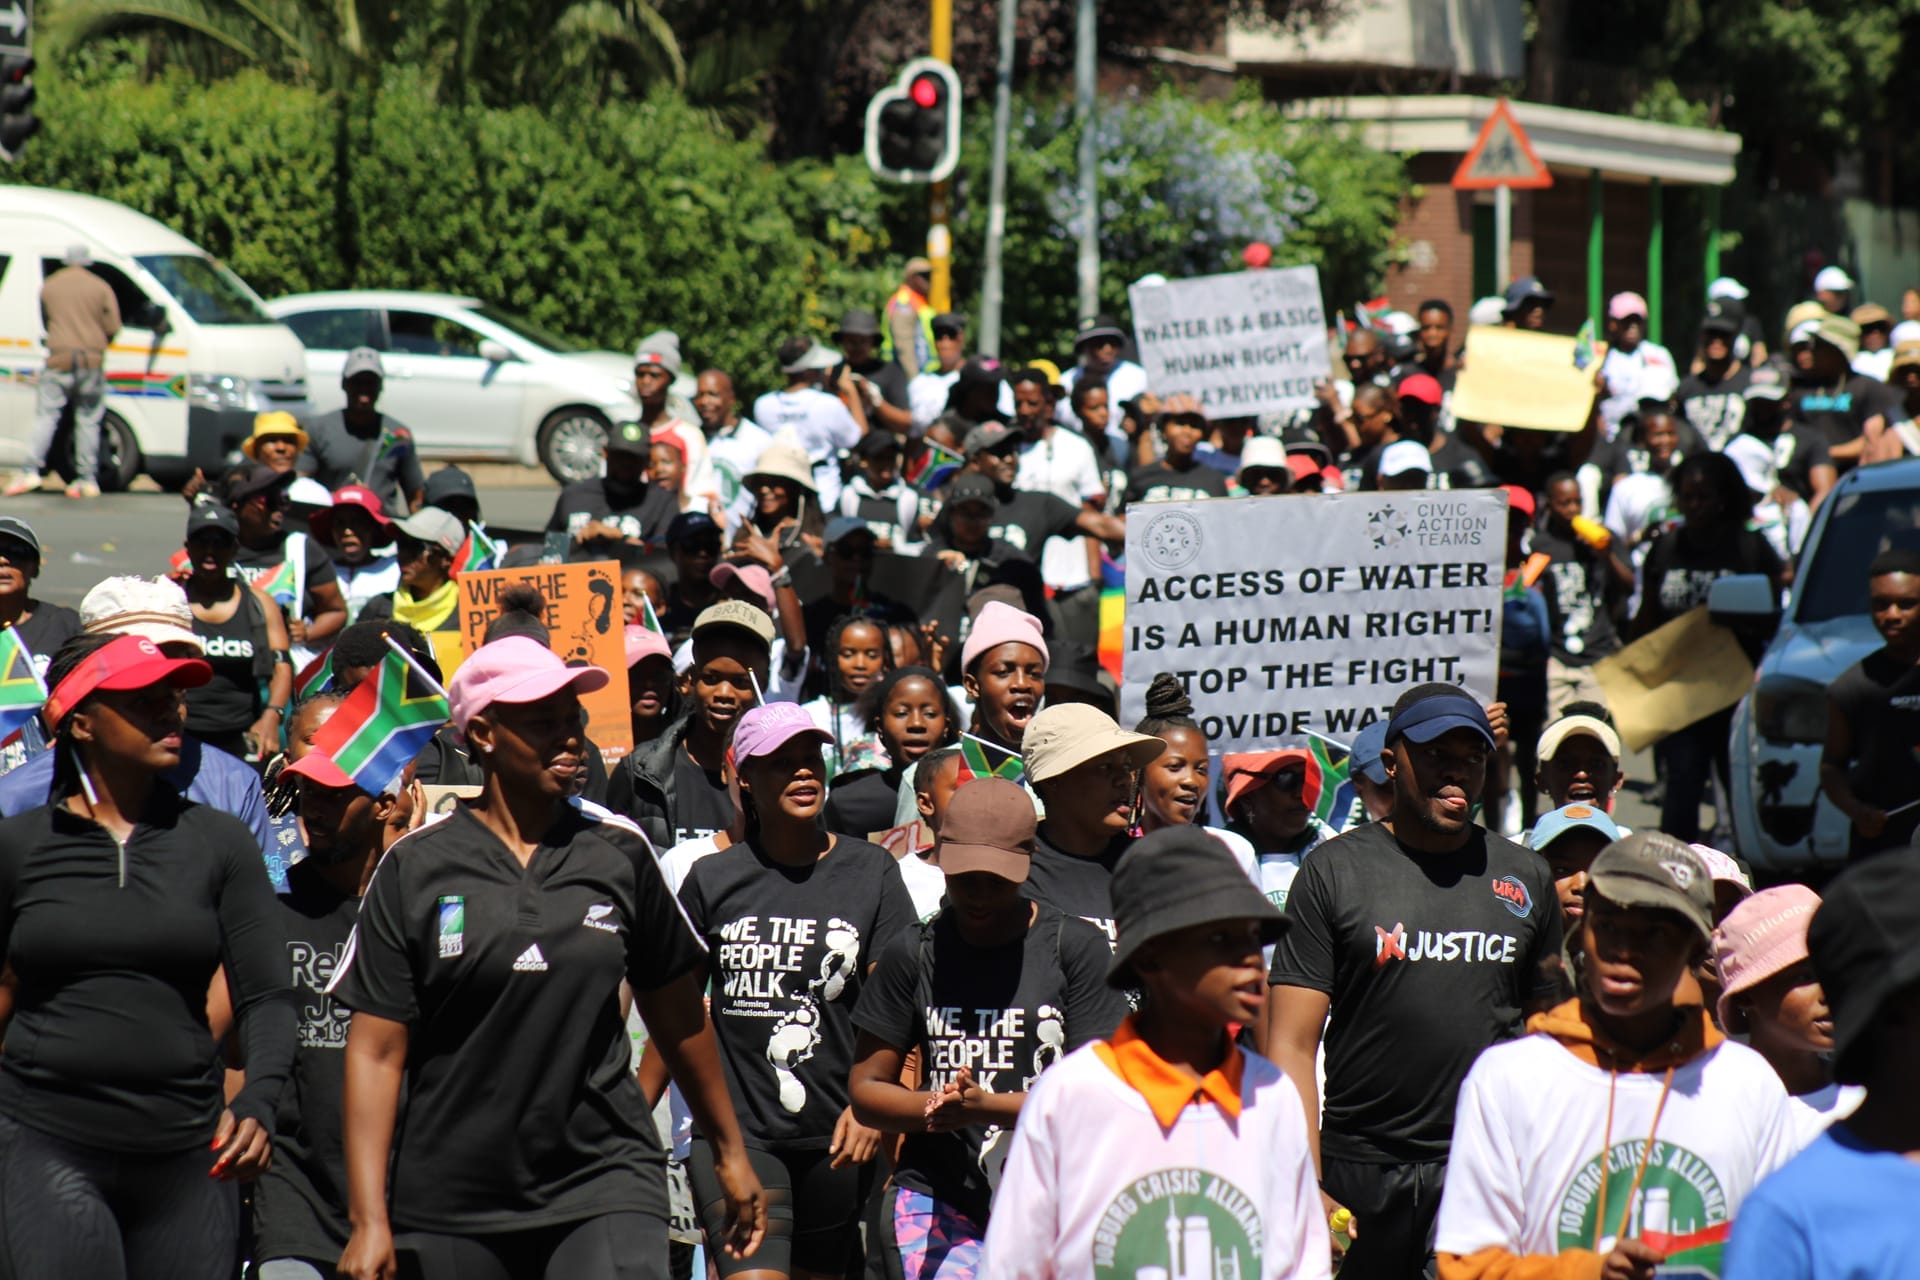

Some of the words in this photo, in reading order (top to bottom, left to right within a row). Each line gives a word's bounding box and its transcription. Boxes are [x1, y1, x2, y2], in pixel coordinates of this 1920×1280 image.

[1142, 320, 1209, 343] WATER
[1215, 316, 1233, 334] IS
[1240, 315, 1254, 331] A
[1258, 307, 1321, 327] BASIC
[1163, 351, 1235, 375] HUMAN
[1417, 503, 1467, 517] CIVIC
[1417, 517, 1487, 531] ACTION
[1417, 531, 1481, 546] TEAMS
[519, 573, 568, 600] THE
[1138, 569, 1284, 603] ACCESS
[1298, 566, 1345, 594] OF
[1360, 562, 1488, 591] WATER
[469, 604, 561, 637] PEE
[1132, 625, 1165, 651] IS
[1178, 622, 1201, 648] A
[1214, 614, 1350, 646] HUMAN
[1365, 608, 1493, 638] RIGHT!
[200, 634, 254, 657] idas
[1176, 666, 1248, 697] TOP
[1261, 661, 1334, 690] THE
[1348, 656, 1466, 687] FIGHT,
[1201, 710, 1312, 741] OVIDE
[1324, 706, 1392, 735] WA
[720, 916, 761, 944] WE,
[768, 917, 817, 944] THE
[512, 961, 549, 972] adidas
[720, 944, 805, 971] PEOPLE
[722, 971, 786, 998] WALK
[722, 1007, 786, 1017] Constitutionalism
[732, 1000, 770, 1009] Affirming
[926, 1006, 967, 1040] WE,
[974, 1008, 1025, 1037] THE
[929, 1040, 1015, 1069] PEOPLE
[929, 1070, 998, 1095] WK
[1094, 1192, 1139, 1268] JOBURG
[1135, 1169, 1202, 1204] CRISIS
[1204, 1176, 1264, 1260] ALLIANCE
